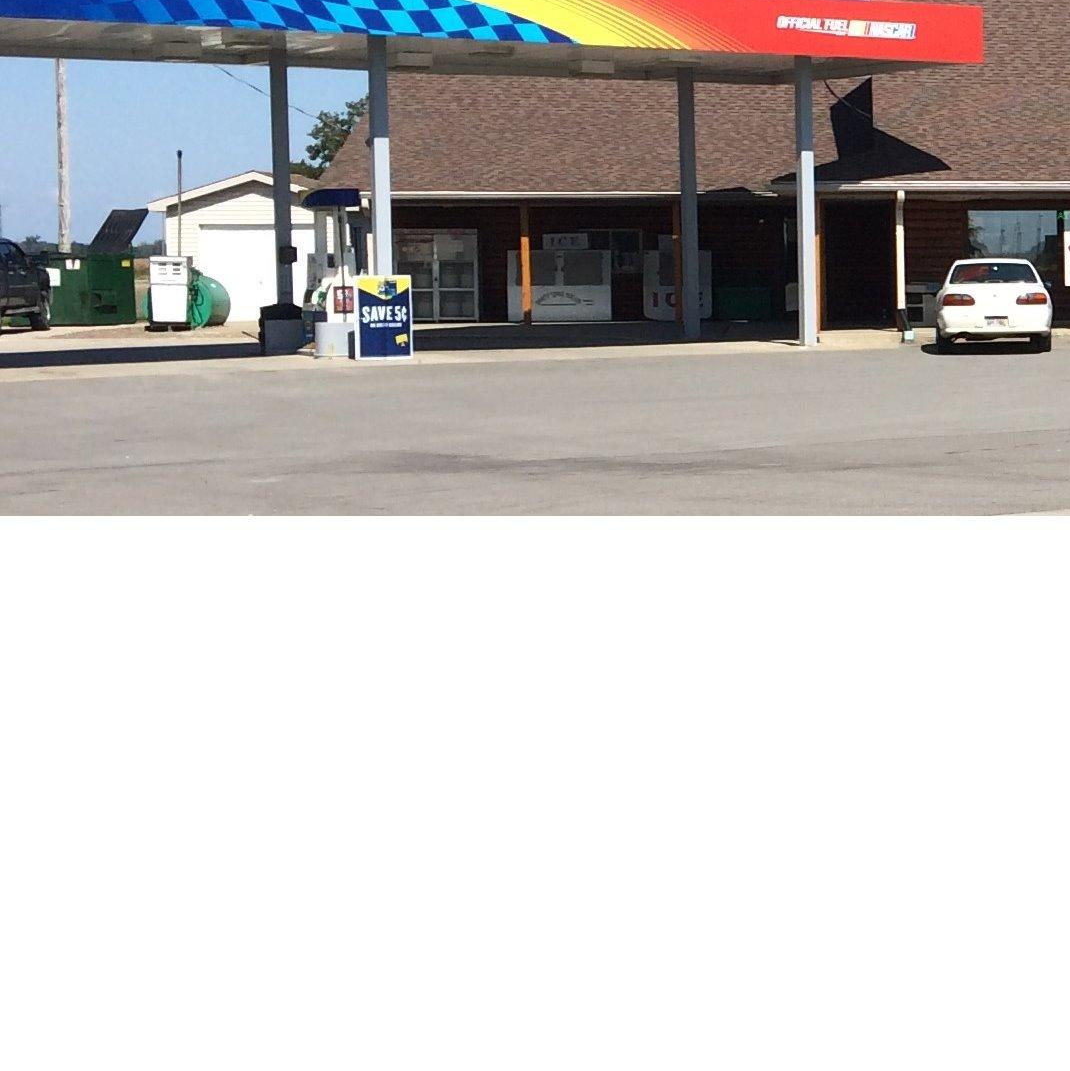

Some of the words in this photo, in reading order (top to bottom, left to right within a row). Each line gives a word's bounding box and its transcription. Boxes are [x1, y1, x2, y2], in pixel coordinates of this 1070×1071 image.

[776, 16, 822, 30] OFFICIAL
[823, 18, 848, 31] FUEL
[361, 305, 393, 323] SAVE
[394, 305, 408, 323] 5¢
